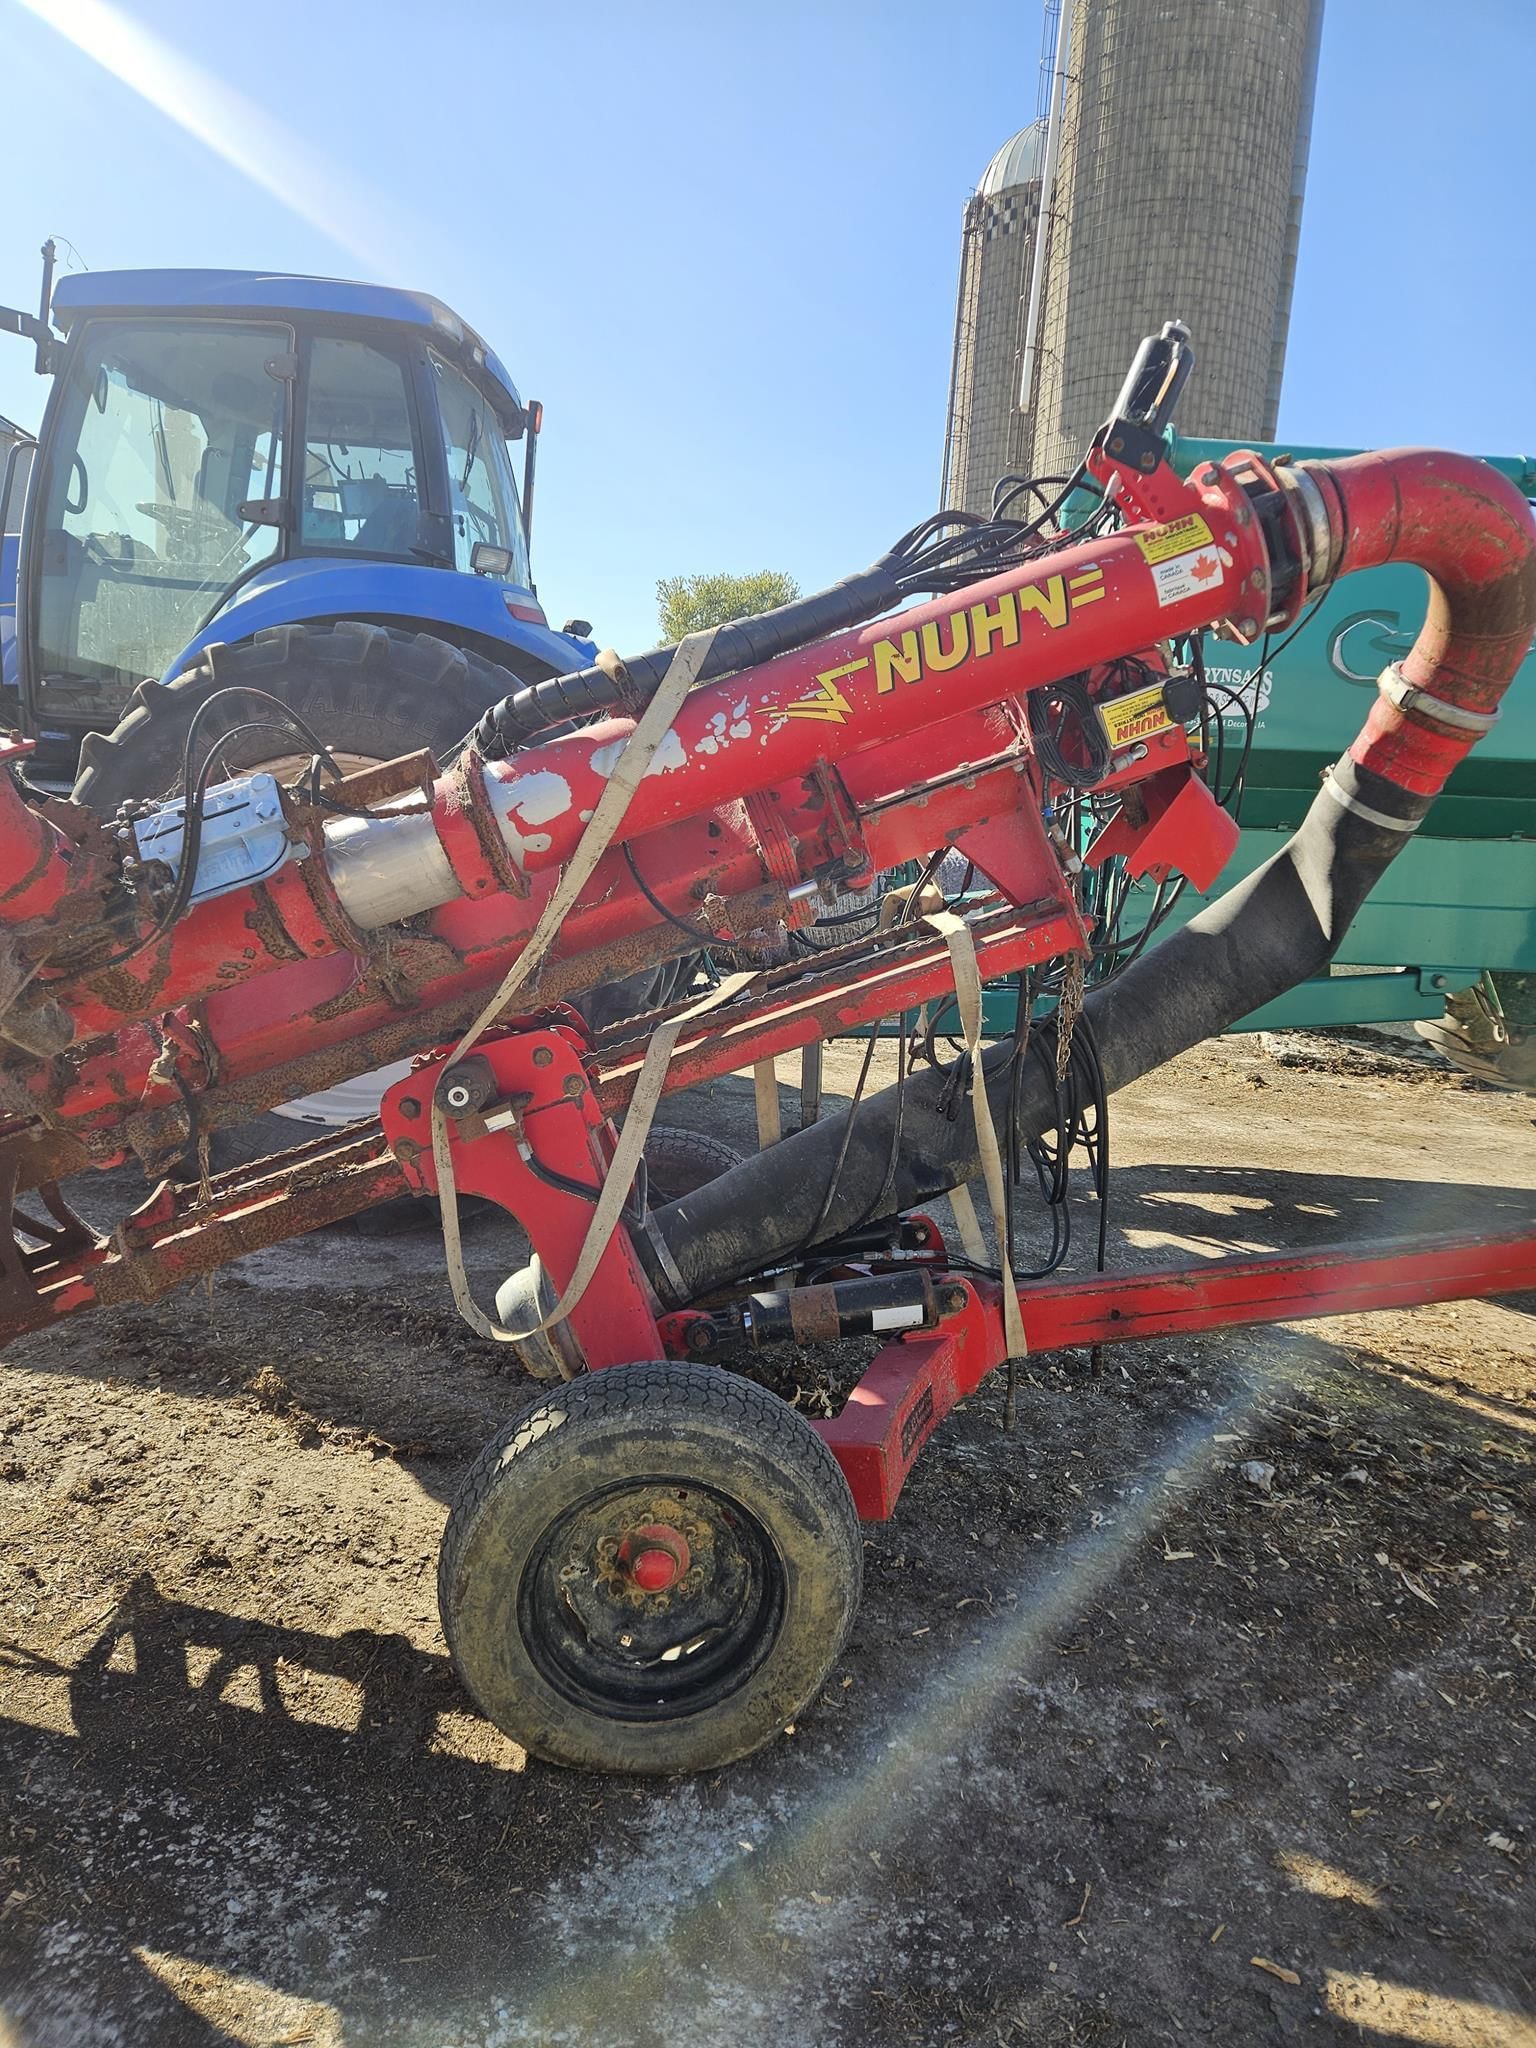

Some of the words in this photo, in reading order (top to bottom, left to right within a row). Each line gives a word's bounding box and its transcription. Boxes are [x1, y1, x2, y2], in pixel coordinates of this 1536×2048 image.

[1142, 516, 1194, 543] NUHN
[1160, 568, 1183, 581] CANADA
[1167, 586, 1191, 599] CANADA
[872, 574, 1069, 694] NUHN
[1116, 711, 1165, 742] NUHN
